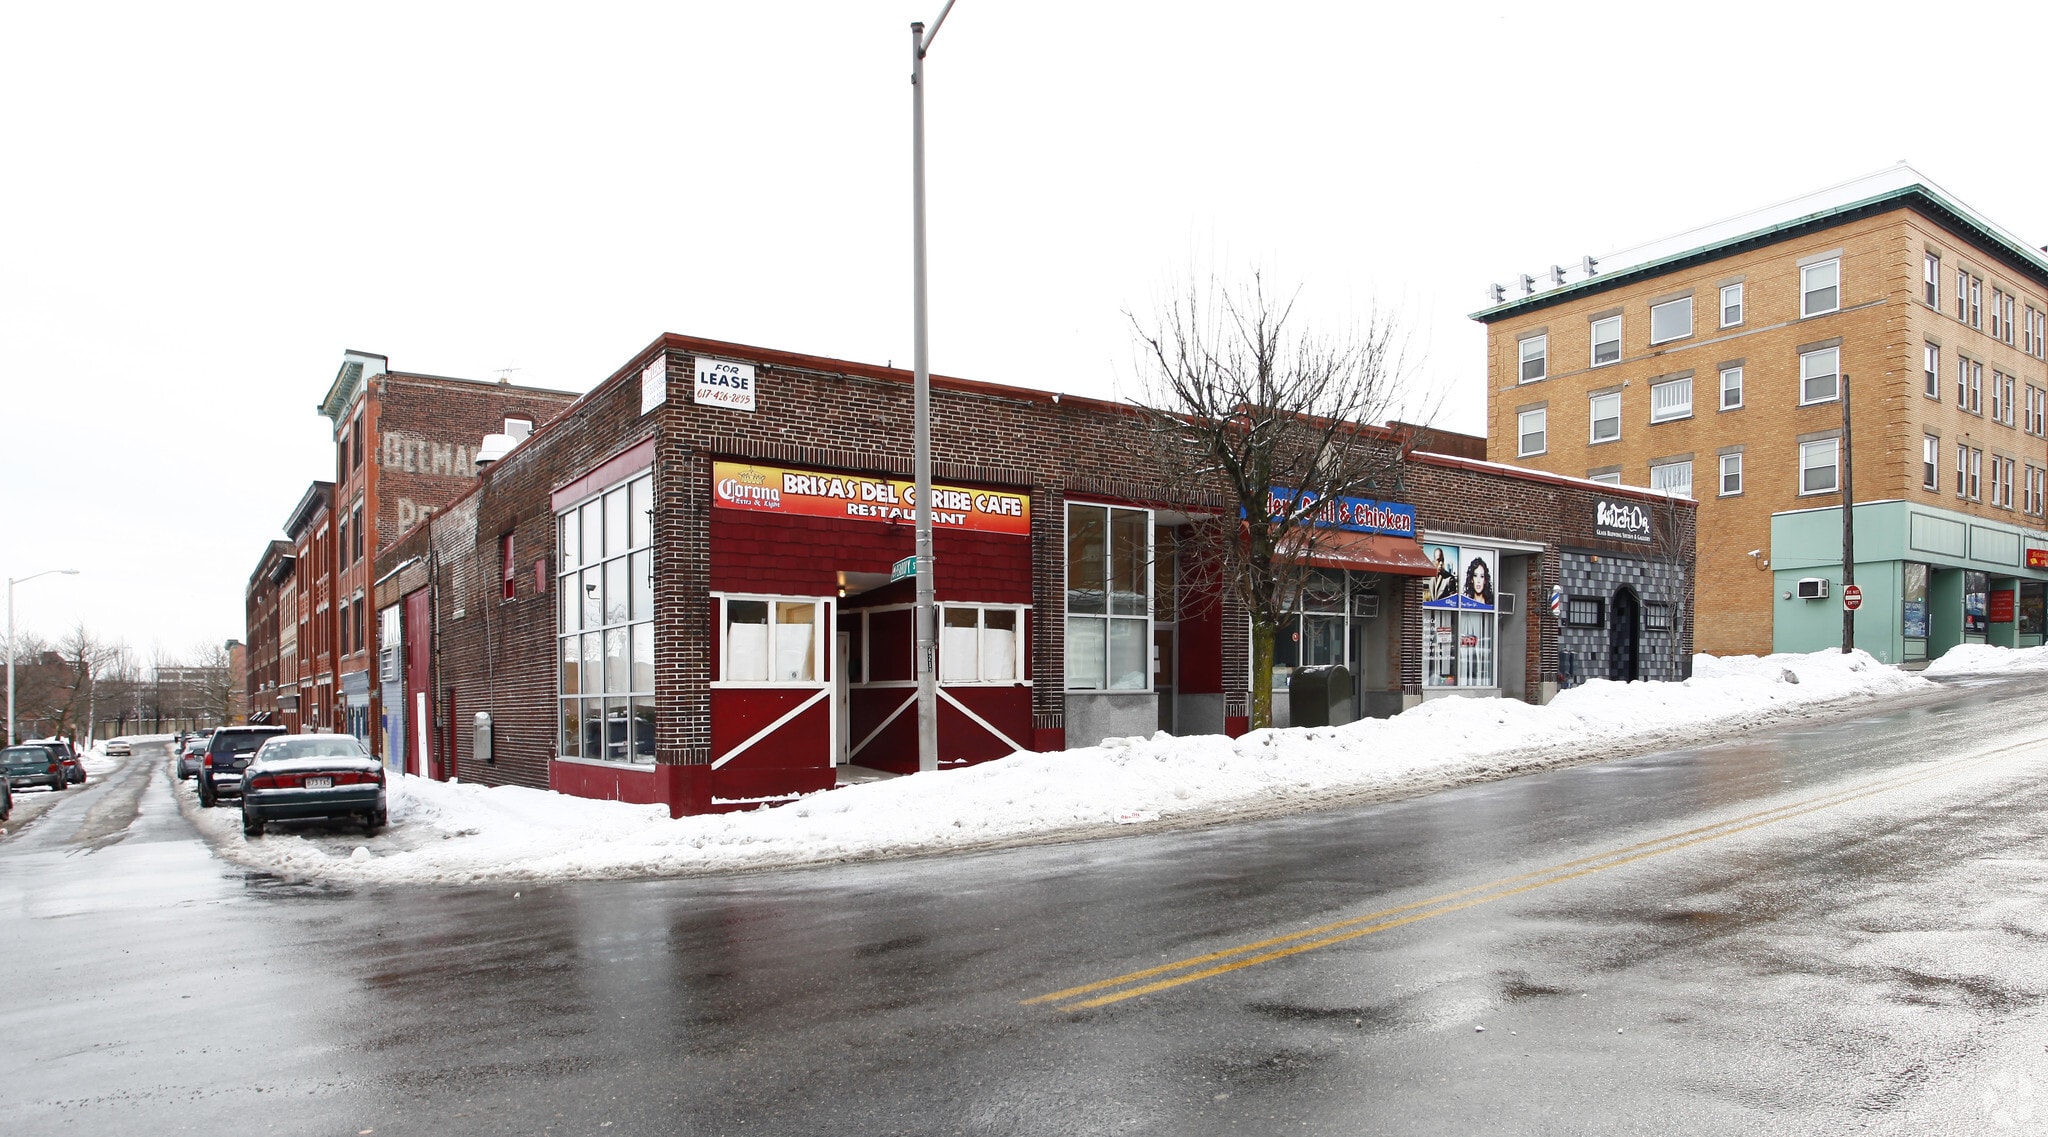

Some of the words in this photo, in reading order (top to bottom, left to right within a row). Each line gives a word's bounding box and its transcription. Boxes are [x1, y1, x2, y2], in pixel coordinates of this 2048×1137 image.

[715, 364, 739, 374] FOR
[701, 371, 748, 390] LEASE
[697, 389, 750, 405] 617-426-2895
[718, 477, 780, 502] Corona
[783, 472, 858, 499] BRISAS
[861, 481, 899, 503] DEL
[903, 487, 971, 511] CRIBE
[975, 494, 1022, 516] CAFE
[847, 503, 966, 525] RESTAUANT
[1339, 502, 1351, 524] &
[1355, 503, 1411, 531] Chicken
